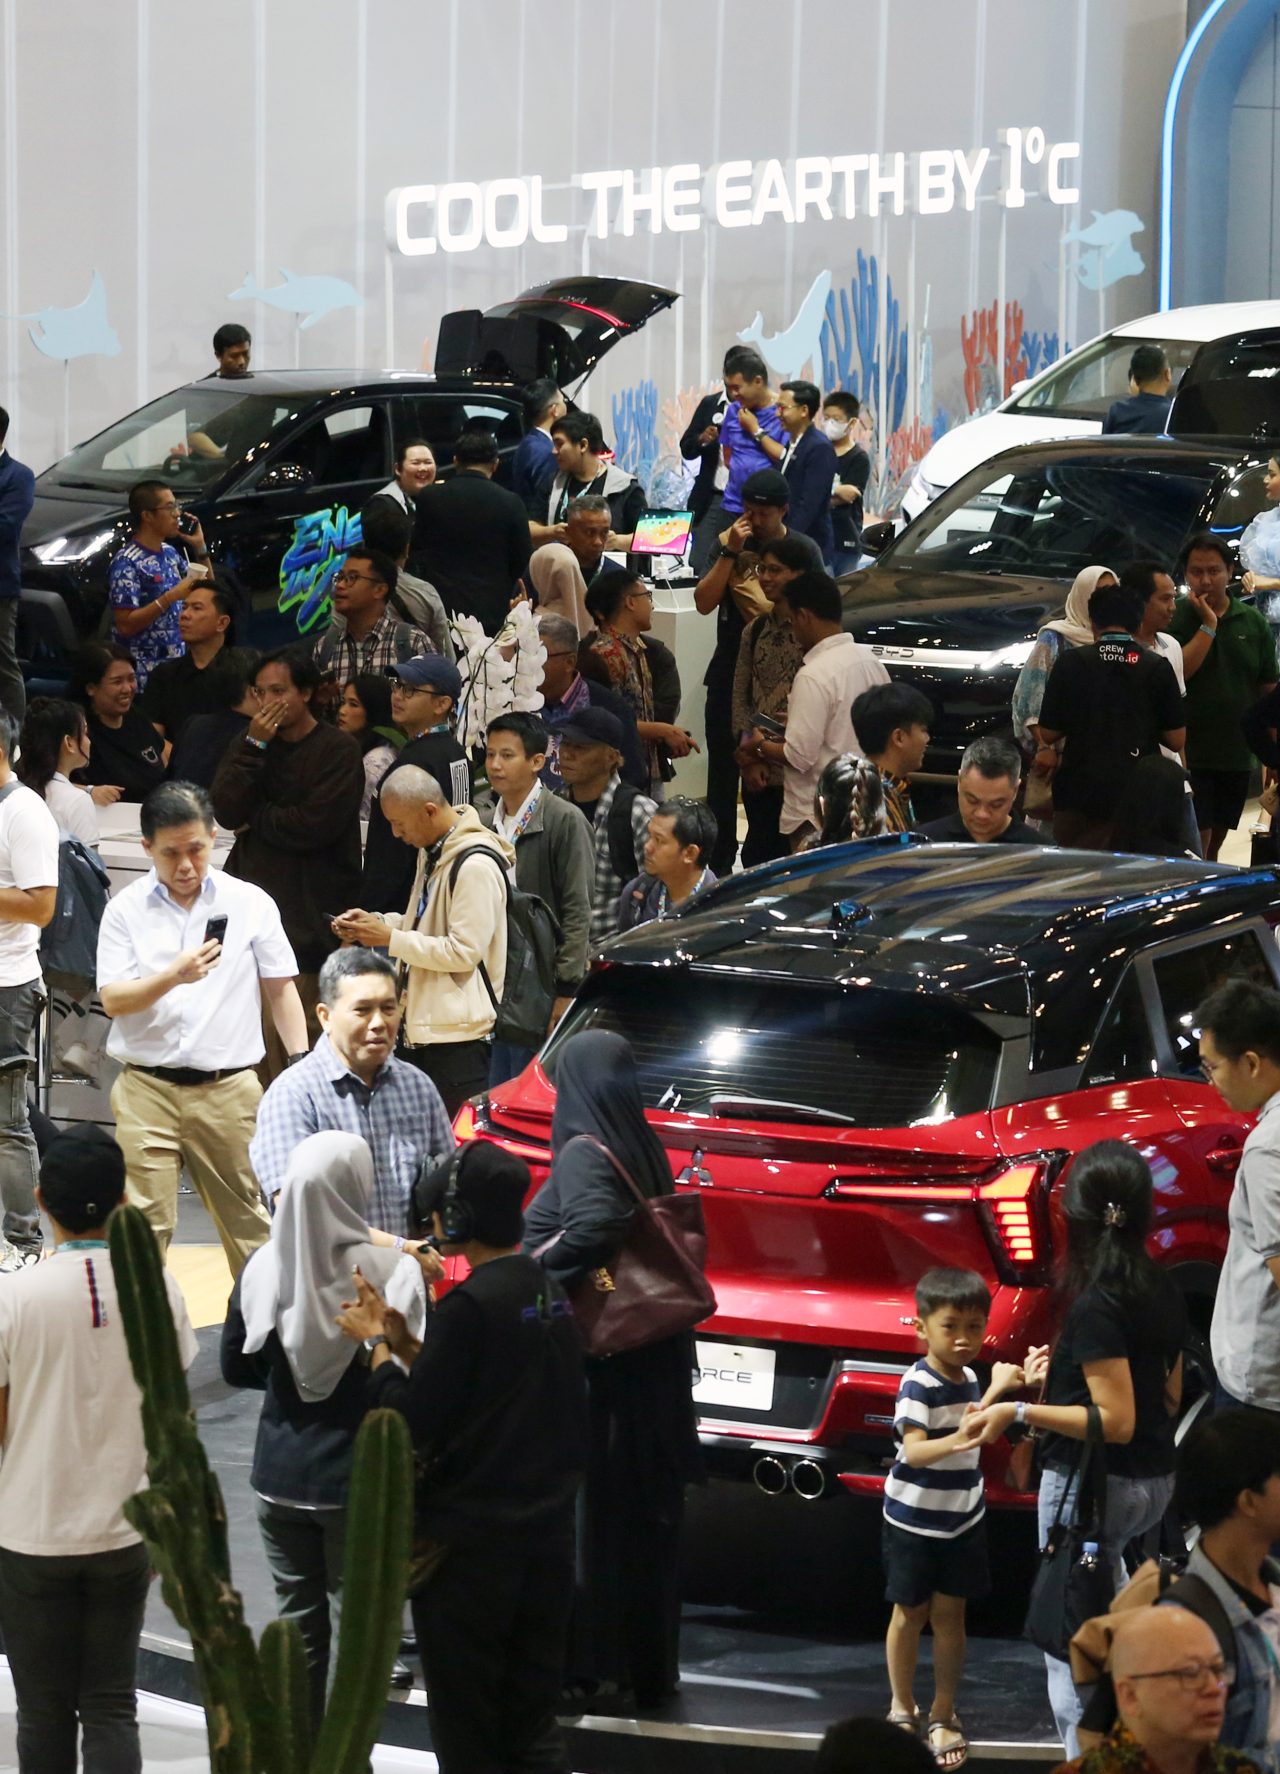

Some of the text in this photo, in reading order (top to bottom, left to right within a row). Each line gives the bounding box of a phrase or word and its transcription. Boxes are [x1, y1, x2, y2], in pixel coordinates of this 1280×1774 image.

[394, 174, 568, 256] COOL
[581, 163, 701, 240] THE
[715, 151, 904, 229] EARTH
[918, 147, 990, 216] BY
[282, 506, 364, 572] ENE
[871, 645, 914, 658] BYD
[1099, 644, 1124, 654] CREW
[702, 1367, 752, 1384] RCE
